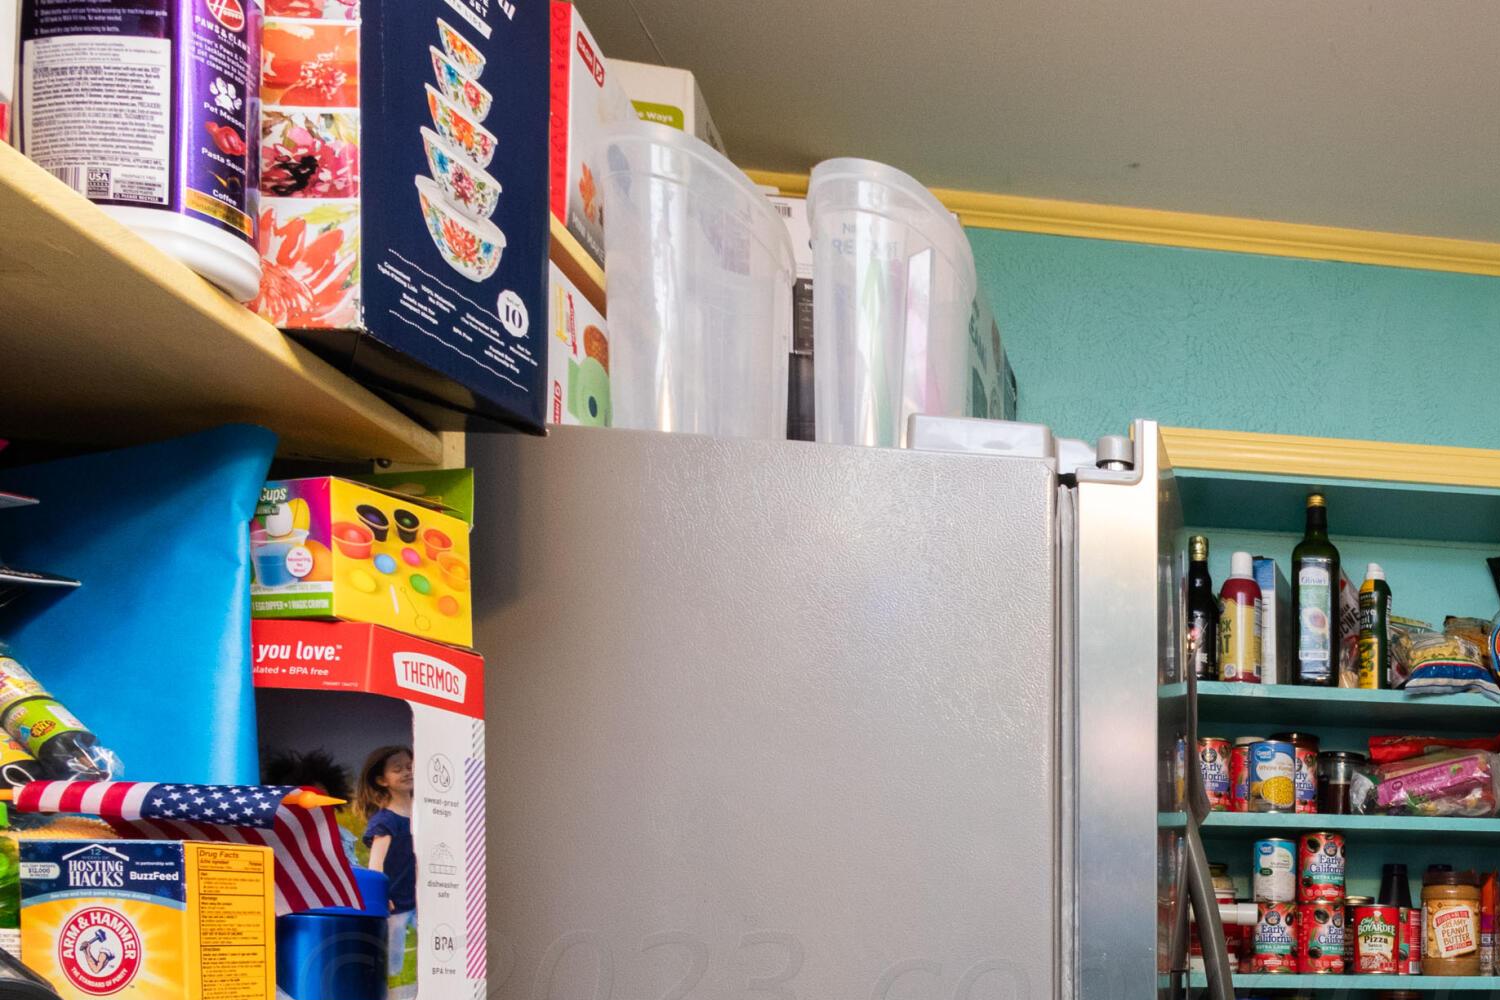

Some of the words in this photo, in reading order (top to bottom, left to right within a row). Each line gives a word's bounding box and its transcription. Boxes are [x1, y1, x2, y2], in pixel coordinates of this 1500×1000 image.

[203, 101, 219, 116] Pet
[647, 111, 674, 124] Ways
[201, 147, 226, 165] Pasta
[89, 172, 108, 182] USA
[212, 188, 237, 206] Coffee
[505, 305, 523, 329] 10
[257, 643, 291, 663] you
[289, 667, 308, 675] BPA
[310, 667, 329, 677] free
[402, 660, 459, 696] THERMOS
[432, 807, 452, 817] design
[199, 850, 218, 860] Drug
[1319, 855, 1341, 867] Early
[69, 860, 123, 874] HOSTING
[68, 872, 124, 887] HACKS
[129, 870, 179, 882] BuzzFeed
[427, 881, 460, 890] dishwasher
[62, 924, 83, 960] ARM
[77, 916, 92, 929] &
[90, 911, 137, 960] HAMMER
[1261, 925, 1286, 938] Early
[1358, 924, 1395, 936] BOYARDEE
[1441, 927, 1468, 938] PEANUT
[434, 935, 454, 951] BPA
[1364, 935, 1388, 945] Pizza
[1443, 934, 1470, 945] BUTTER
[71, 967, 80, 979] THE
[79, 973, 106, 988] STANDARD
[112, 968, 129, 985] PURITY
[432, 967, 443, 975] BPA
[444, 967, 456, 975] free
